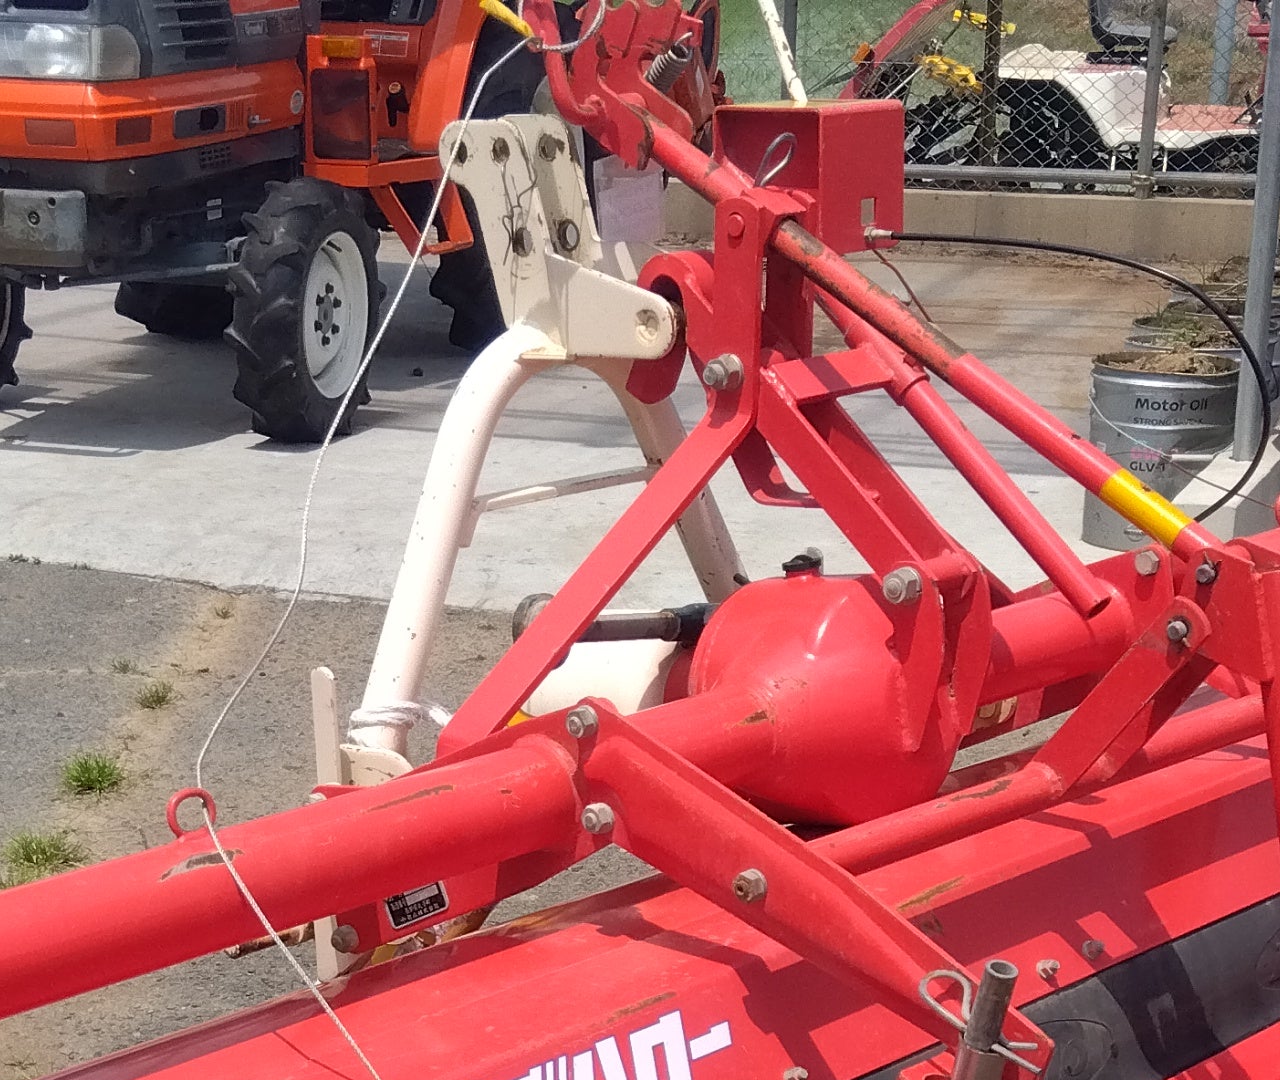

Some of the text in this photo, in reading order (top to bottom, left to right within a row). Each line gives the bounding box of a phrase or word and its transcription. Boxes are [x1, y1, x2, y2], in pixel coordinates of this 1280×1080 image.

[1135, 397, 1208, 412] Motor Oil
[1132, 417, 1173, 426] STRONG
[1129, 461, 1166, 473] GLV-1
